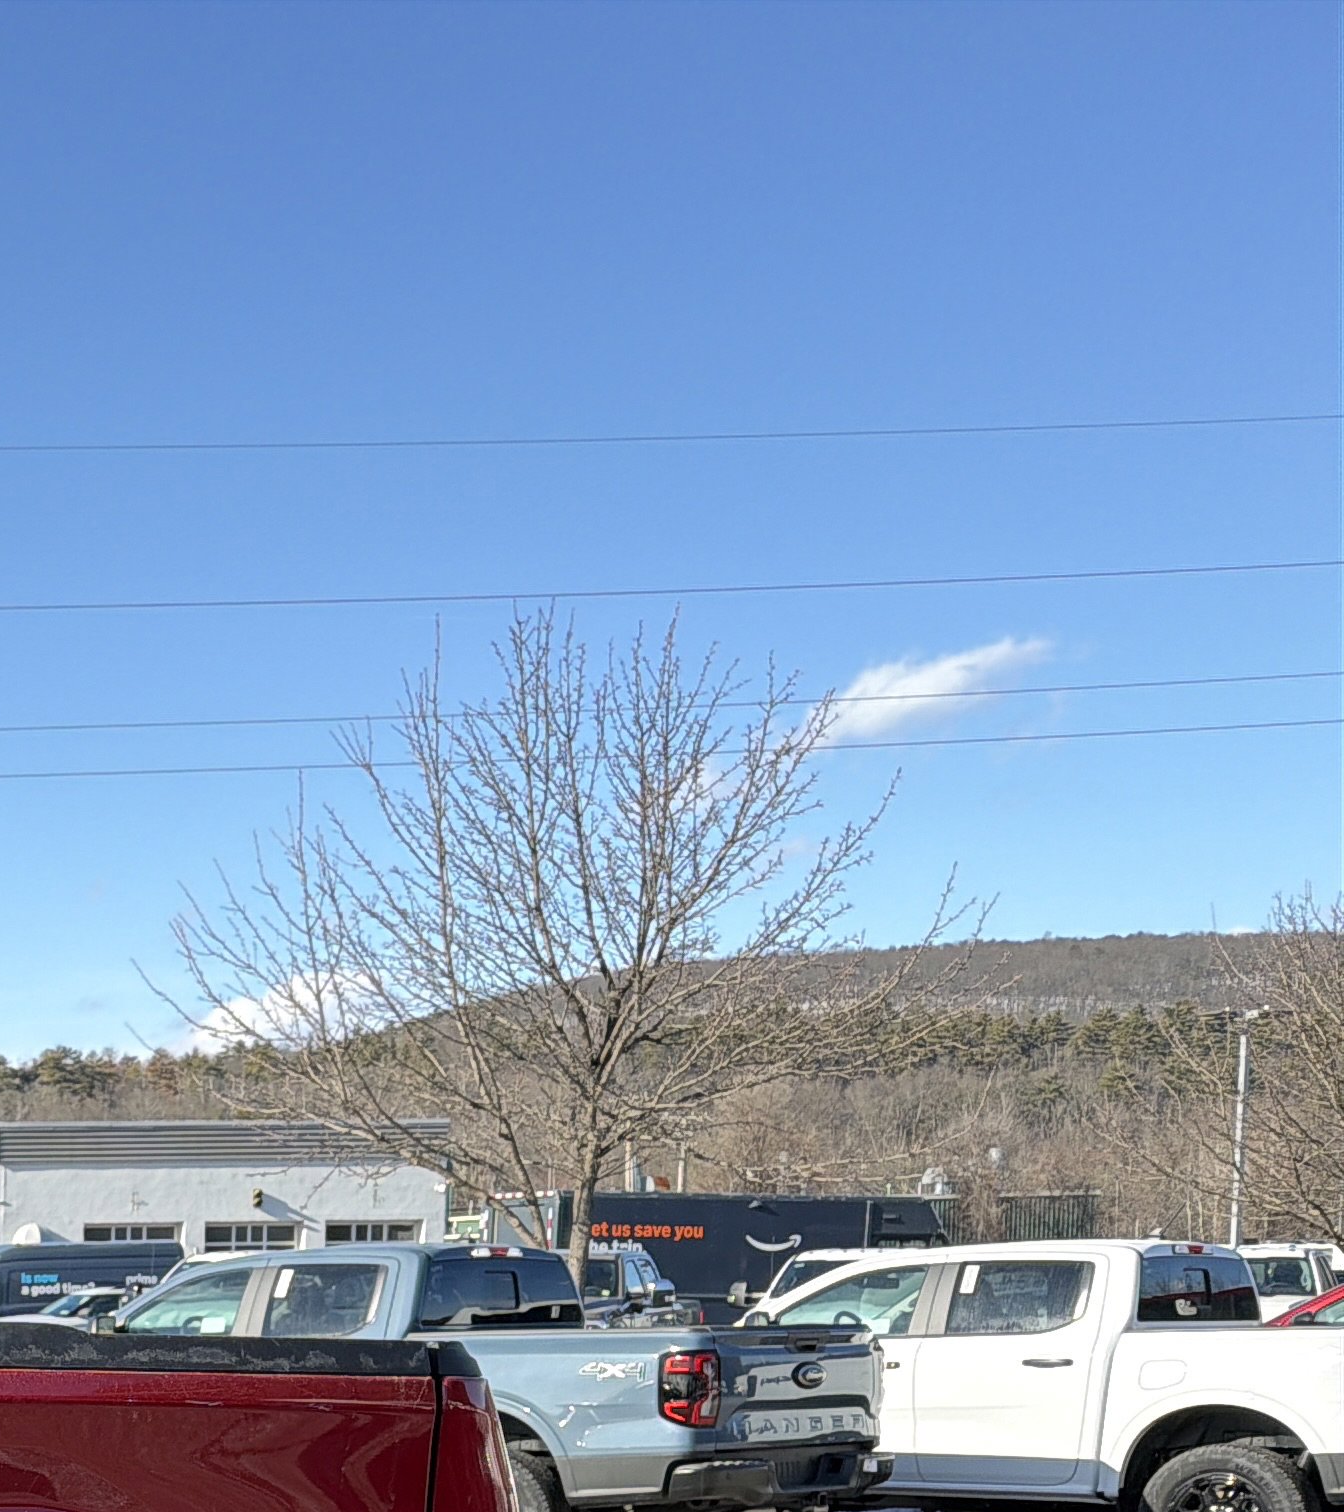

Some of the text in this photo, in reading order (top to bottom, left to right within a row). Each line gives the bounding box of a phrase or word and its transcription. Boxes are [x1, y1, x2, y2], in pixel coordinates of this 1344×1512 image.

[591, 1221, 704, 1241] et us save you
[21, 1285, 29, 1295] a
[31, 1282, 60, 1297] good
